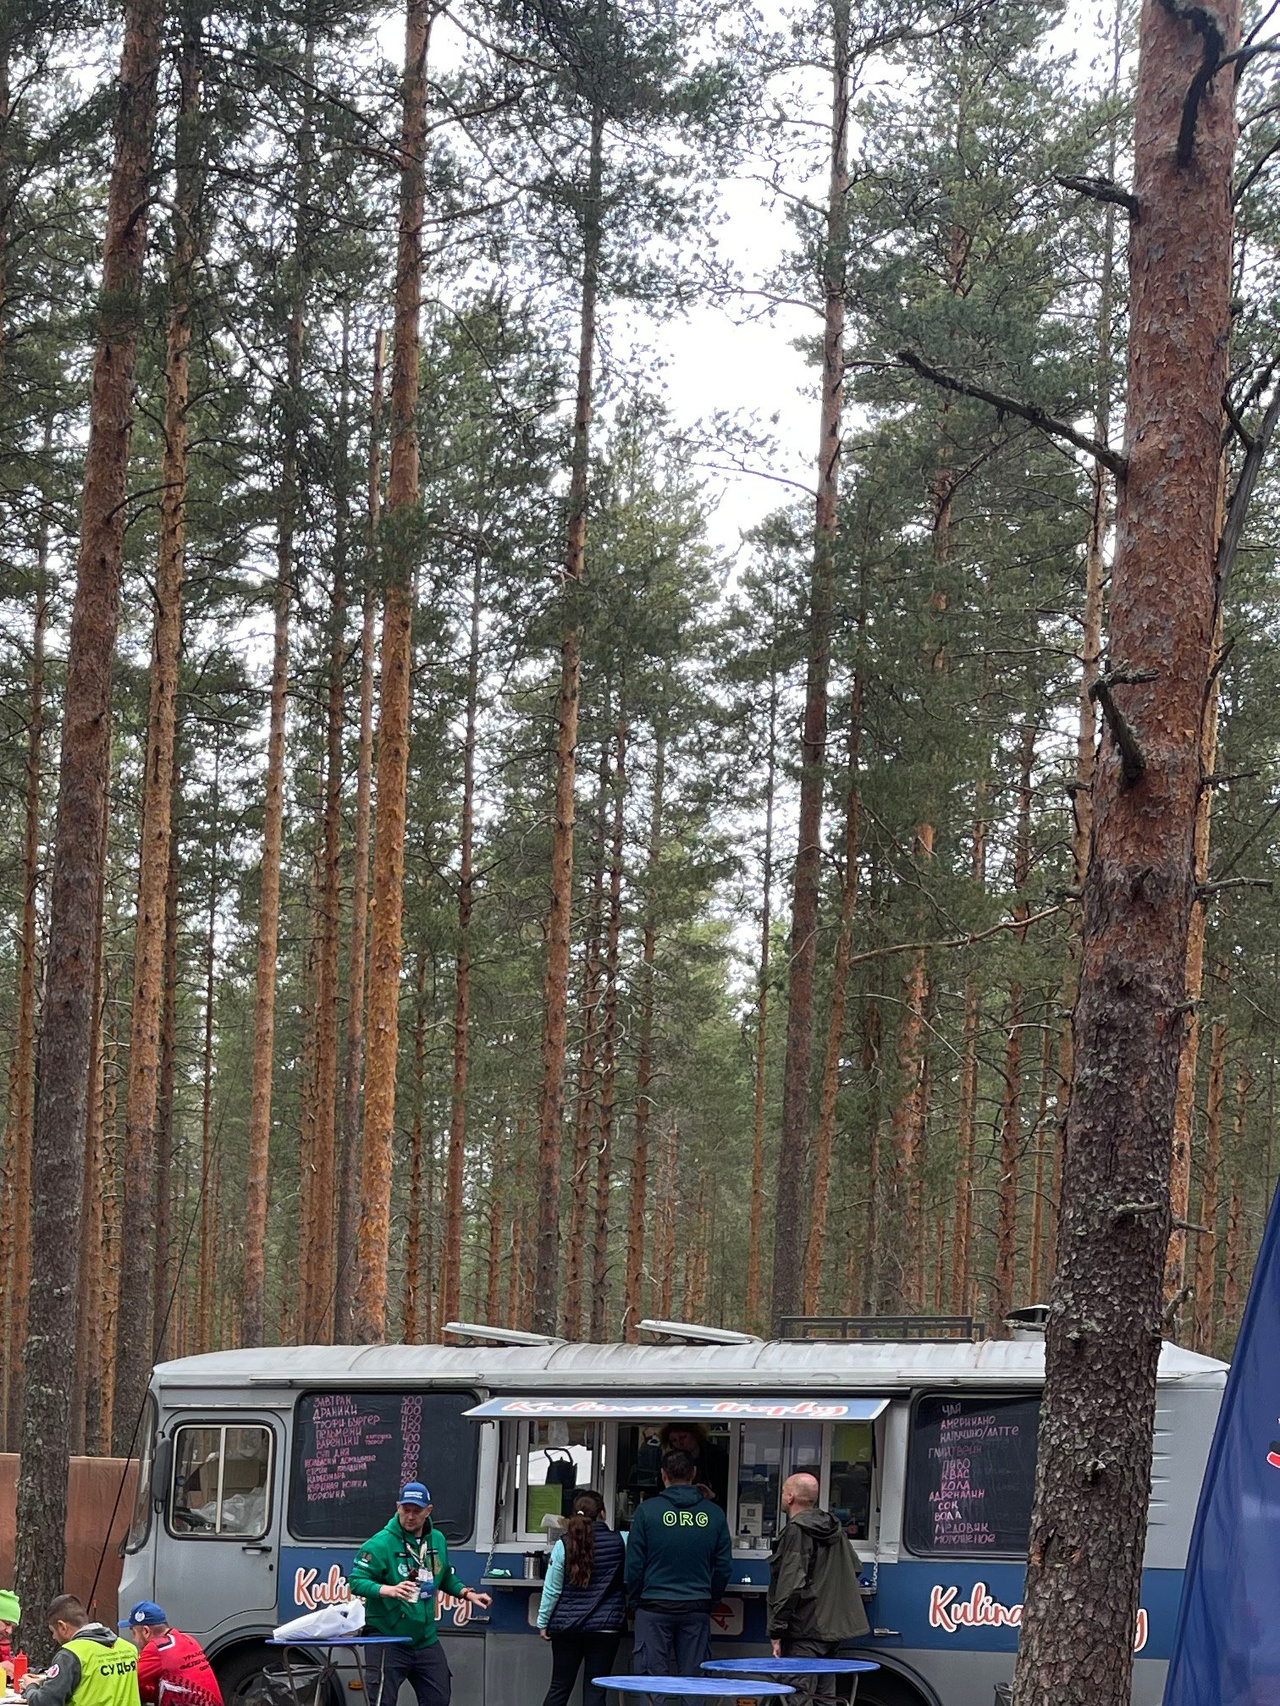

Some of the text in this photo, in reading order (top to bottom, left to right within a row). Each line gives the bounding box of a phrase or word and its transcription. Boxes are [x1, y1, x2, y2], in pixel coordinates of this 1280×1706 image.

[313, 1395, 423, 1408] ЗАВТРАК 500
[313, 1404, 421, 1421] ДРАНИКИ 400
[316, 1427, 361, 1440] ПЕЛЬМЕНИ
[316, 1436, 360, 1450] ВАРЕНИКИ
[402, 1434, 420, 1443] 400
[942, 1458, 971, 1472] ПИВО
[942, 1470, 970, 1480] КВАС
[940, 1480, 970, 1491] КОЛА
[307, 1489, 345, 1501] КОРЮШКА
[928, 1489, 985, 1502] АДРЕНАЛИН
[938, 1500, 959, 1510] СОК
[663, 1510, 709, 1527] ORG
[935, 1522, 990, 1534] МЕДОВИК
[100, 1660, 137, 1677] СУДЬЯ
